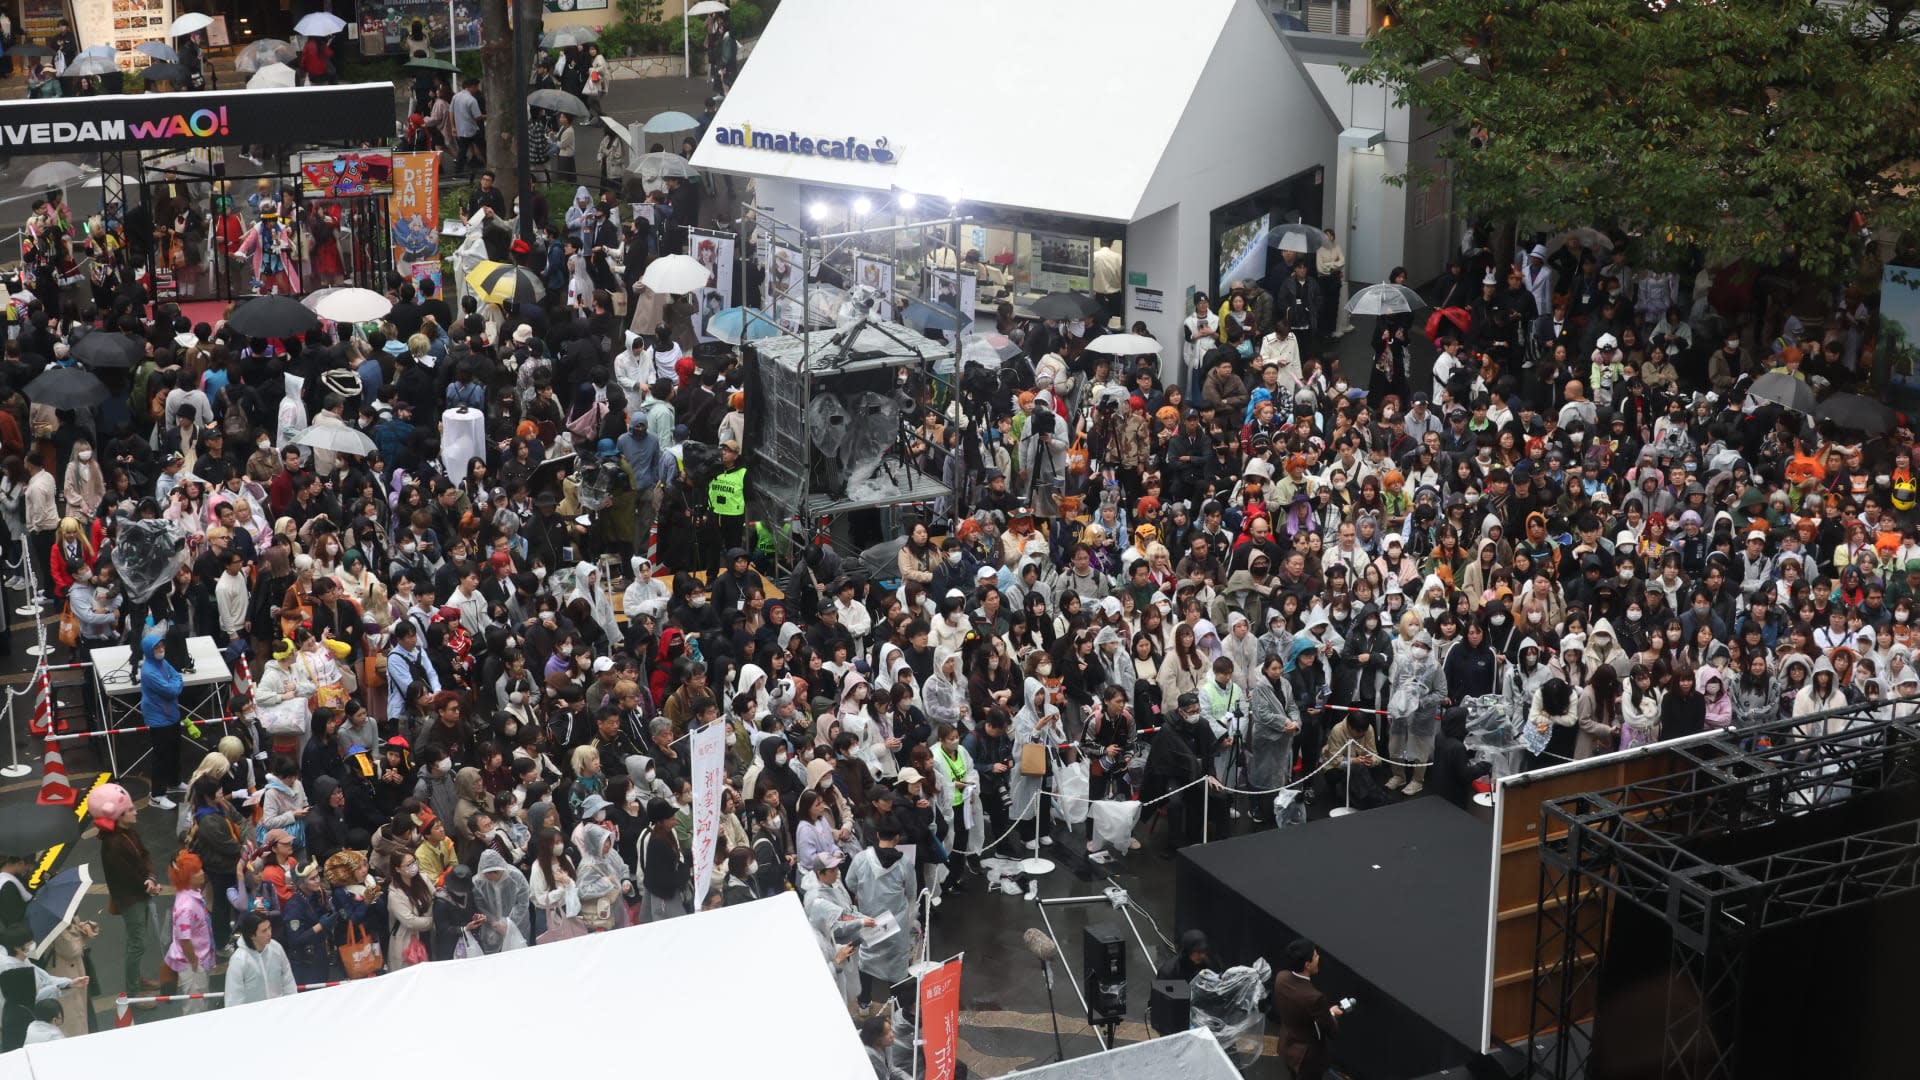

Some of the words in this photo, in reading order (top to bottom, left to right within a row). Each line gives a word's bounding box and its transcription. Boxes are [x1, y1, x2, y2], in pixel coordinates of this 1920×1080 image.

[128, 105, 230, 139] WAO!
[715, 121, 814, 154] animate
[816, 136, 870, 161] cafe
[404, 169, 416, 207] DAM
[711, 484, 735, 494] OFFICIAL
